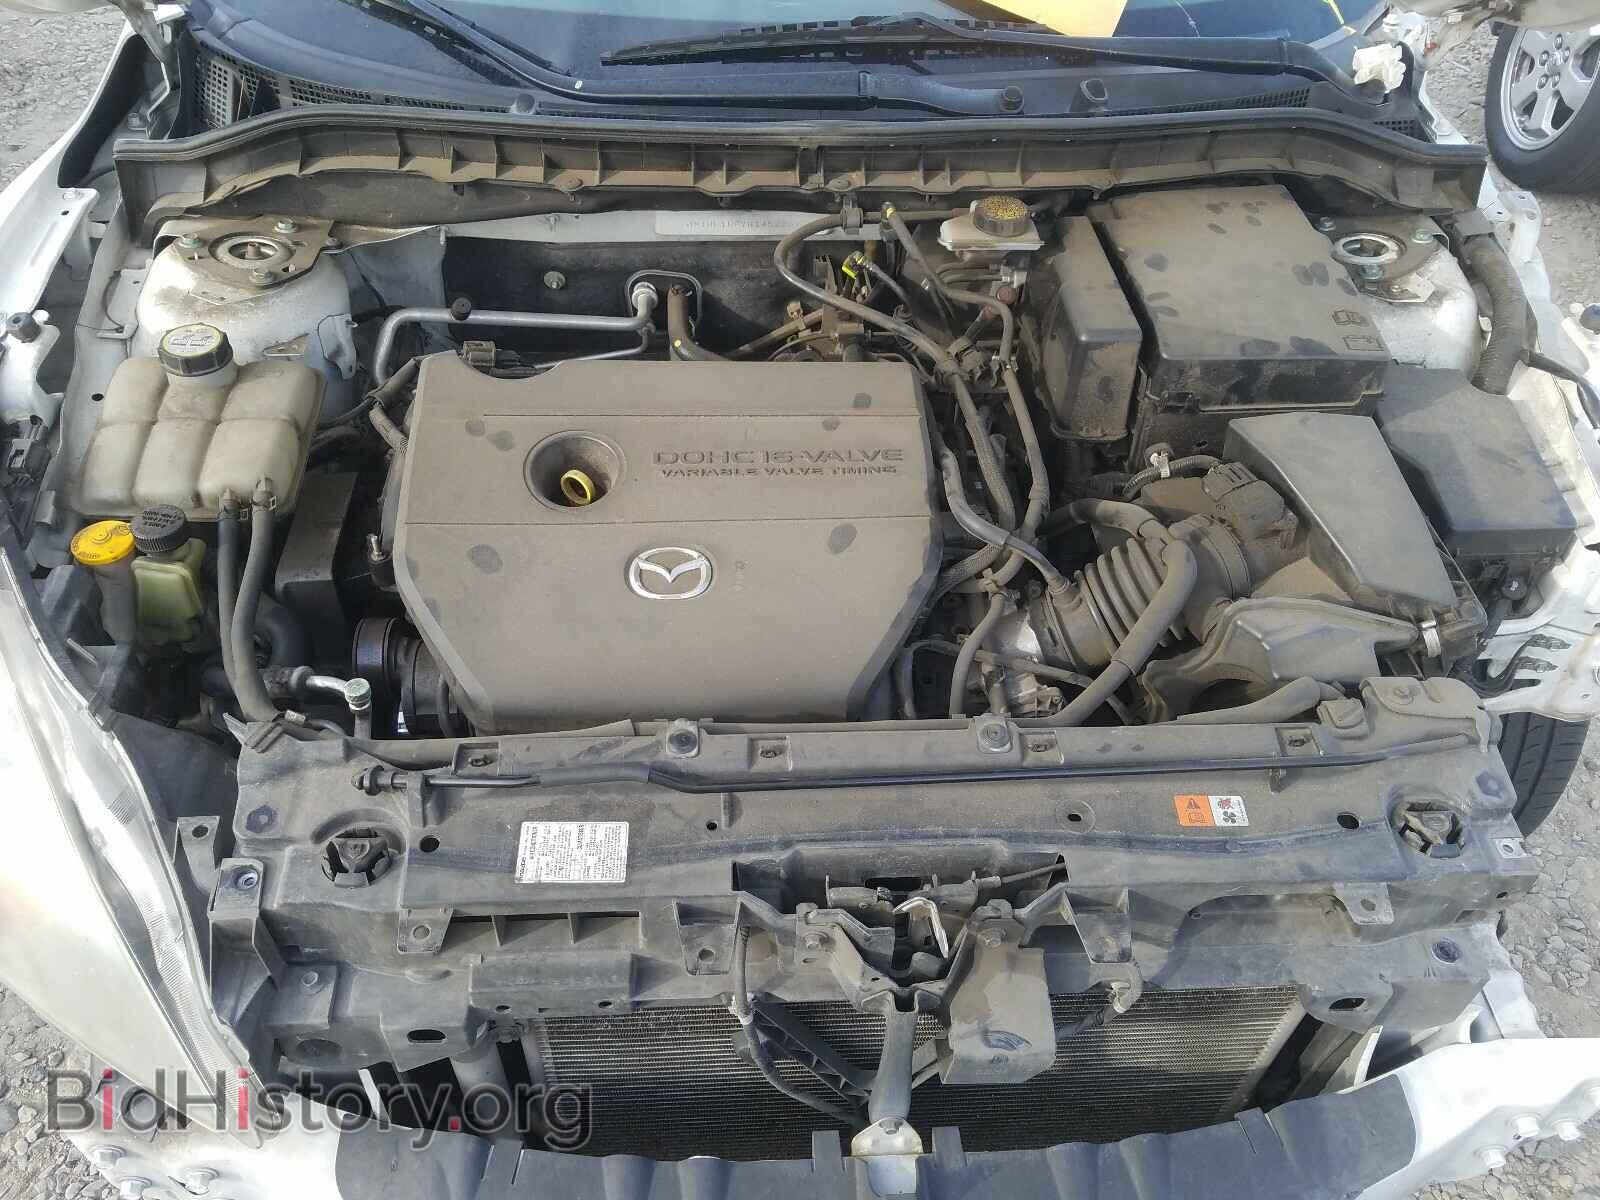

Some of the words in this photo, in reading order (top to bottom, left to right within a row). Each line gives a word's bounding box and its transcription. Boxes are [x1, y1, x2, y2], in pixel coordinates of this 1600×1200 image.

[654, 451, 755, 465] DOHC
[662, 467, 760, 478] VARIABLE
[763, 466, 825, 477] VALVE
[831, 465, 898, 476] TIMING
